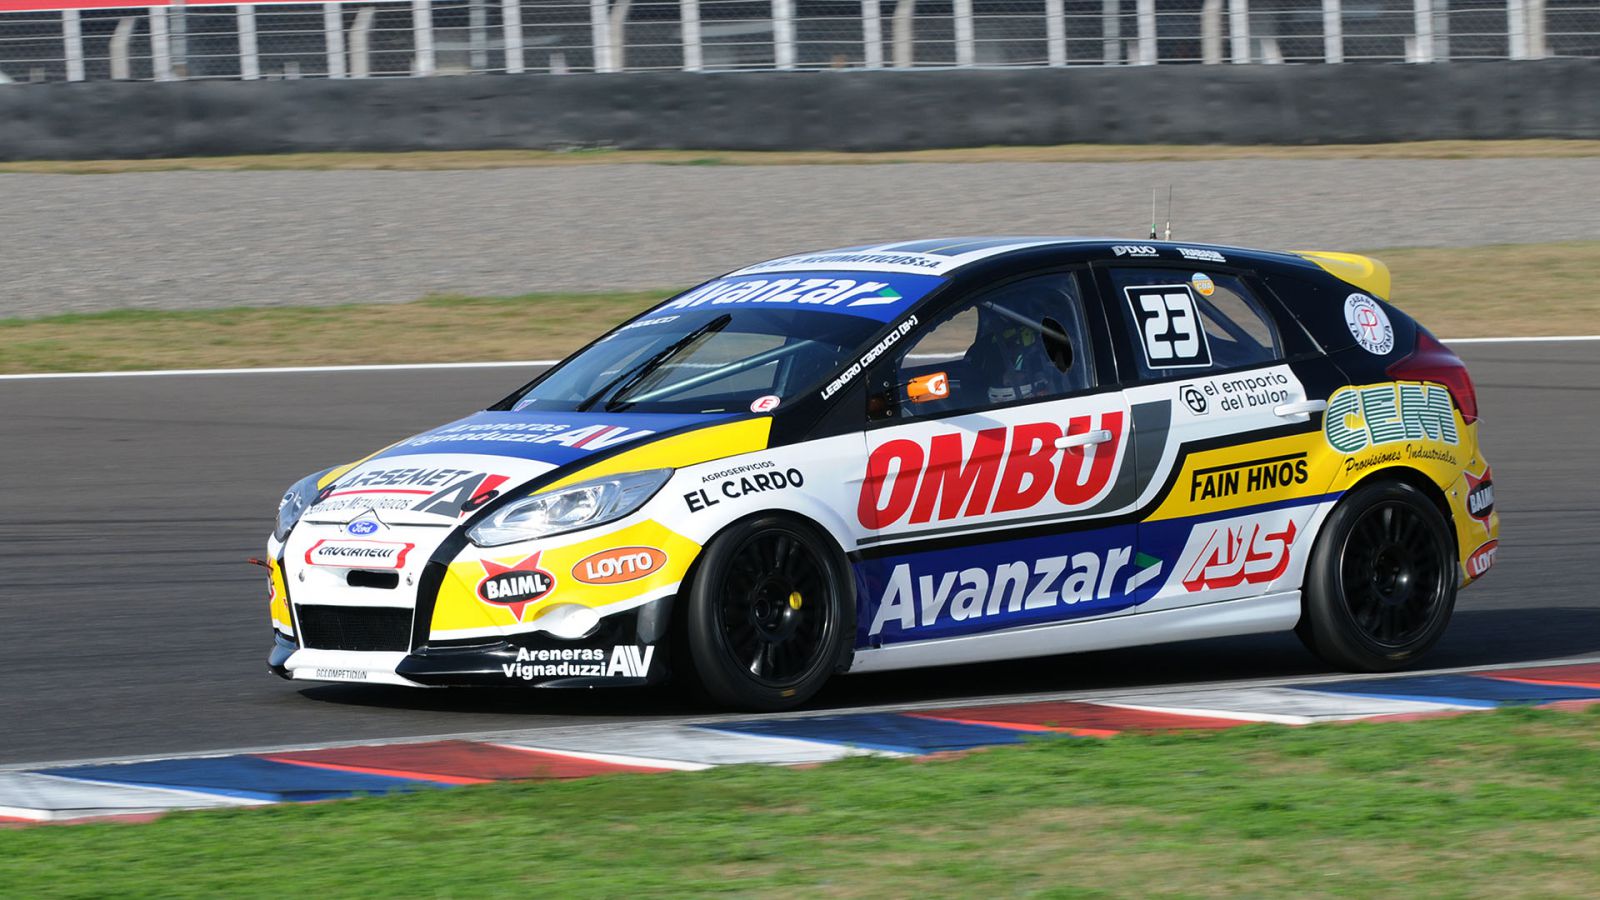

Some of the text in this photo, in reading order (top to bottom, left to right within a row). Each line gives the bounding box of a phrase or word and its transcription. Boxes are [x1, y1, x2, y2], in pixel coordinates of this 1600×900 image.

[1139, 293, 1199, 359] 23
[1203, 372, 1288, 396] el emporio
[758, 398, 773, 409] E
[1220, 389, 1289, 412] del bulon
[1325, 384, 1460, 453] CEM
[701, 460, 776, 483] AGROSERVICIOS
[856, 411, 1125, 530] OMBU
[1344, 443, 1457, 477] Provisiones Industriales
[339, 467, 472, 489] ARSEMET
[683, 467, 804, 513] EL CARDO
[1190, 458, 1309, 502] FAIN HNOS
[352, 521, 374, 533] Ford
[586, 551, 654, 580] LOYTO
[486, 574, 547, 600] BAIML
[870, 546, 1132, 635] Avanzar
[516, 646, 604, 662] Areneras
[502, 662, 606, 680] Vignaduzzi
